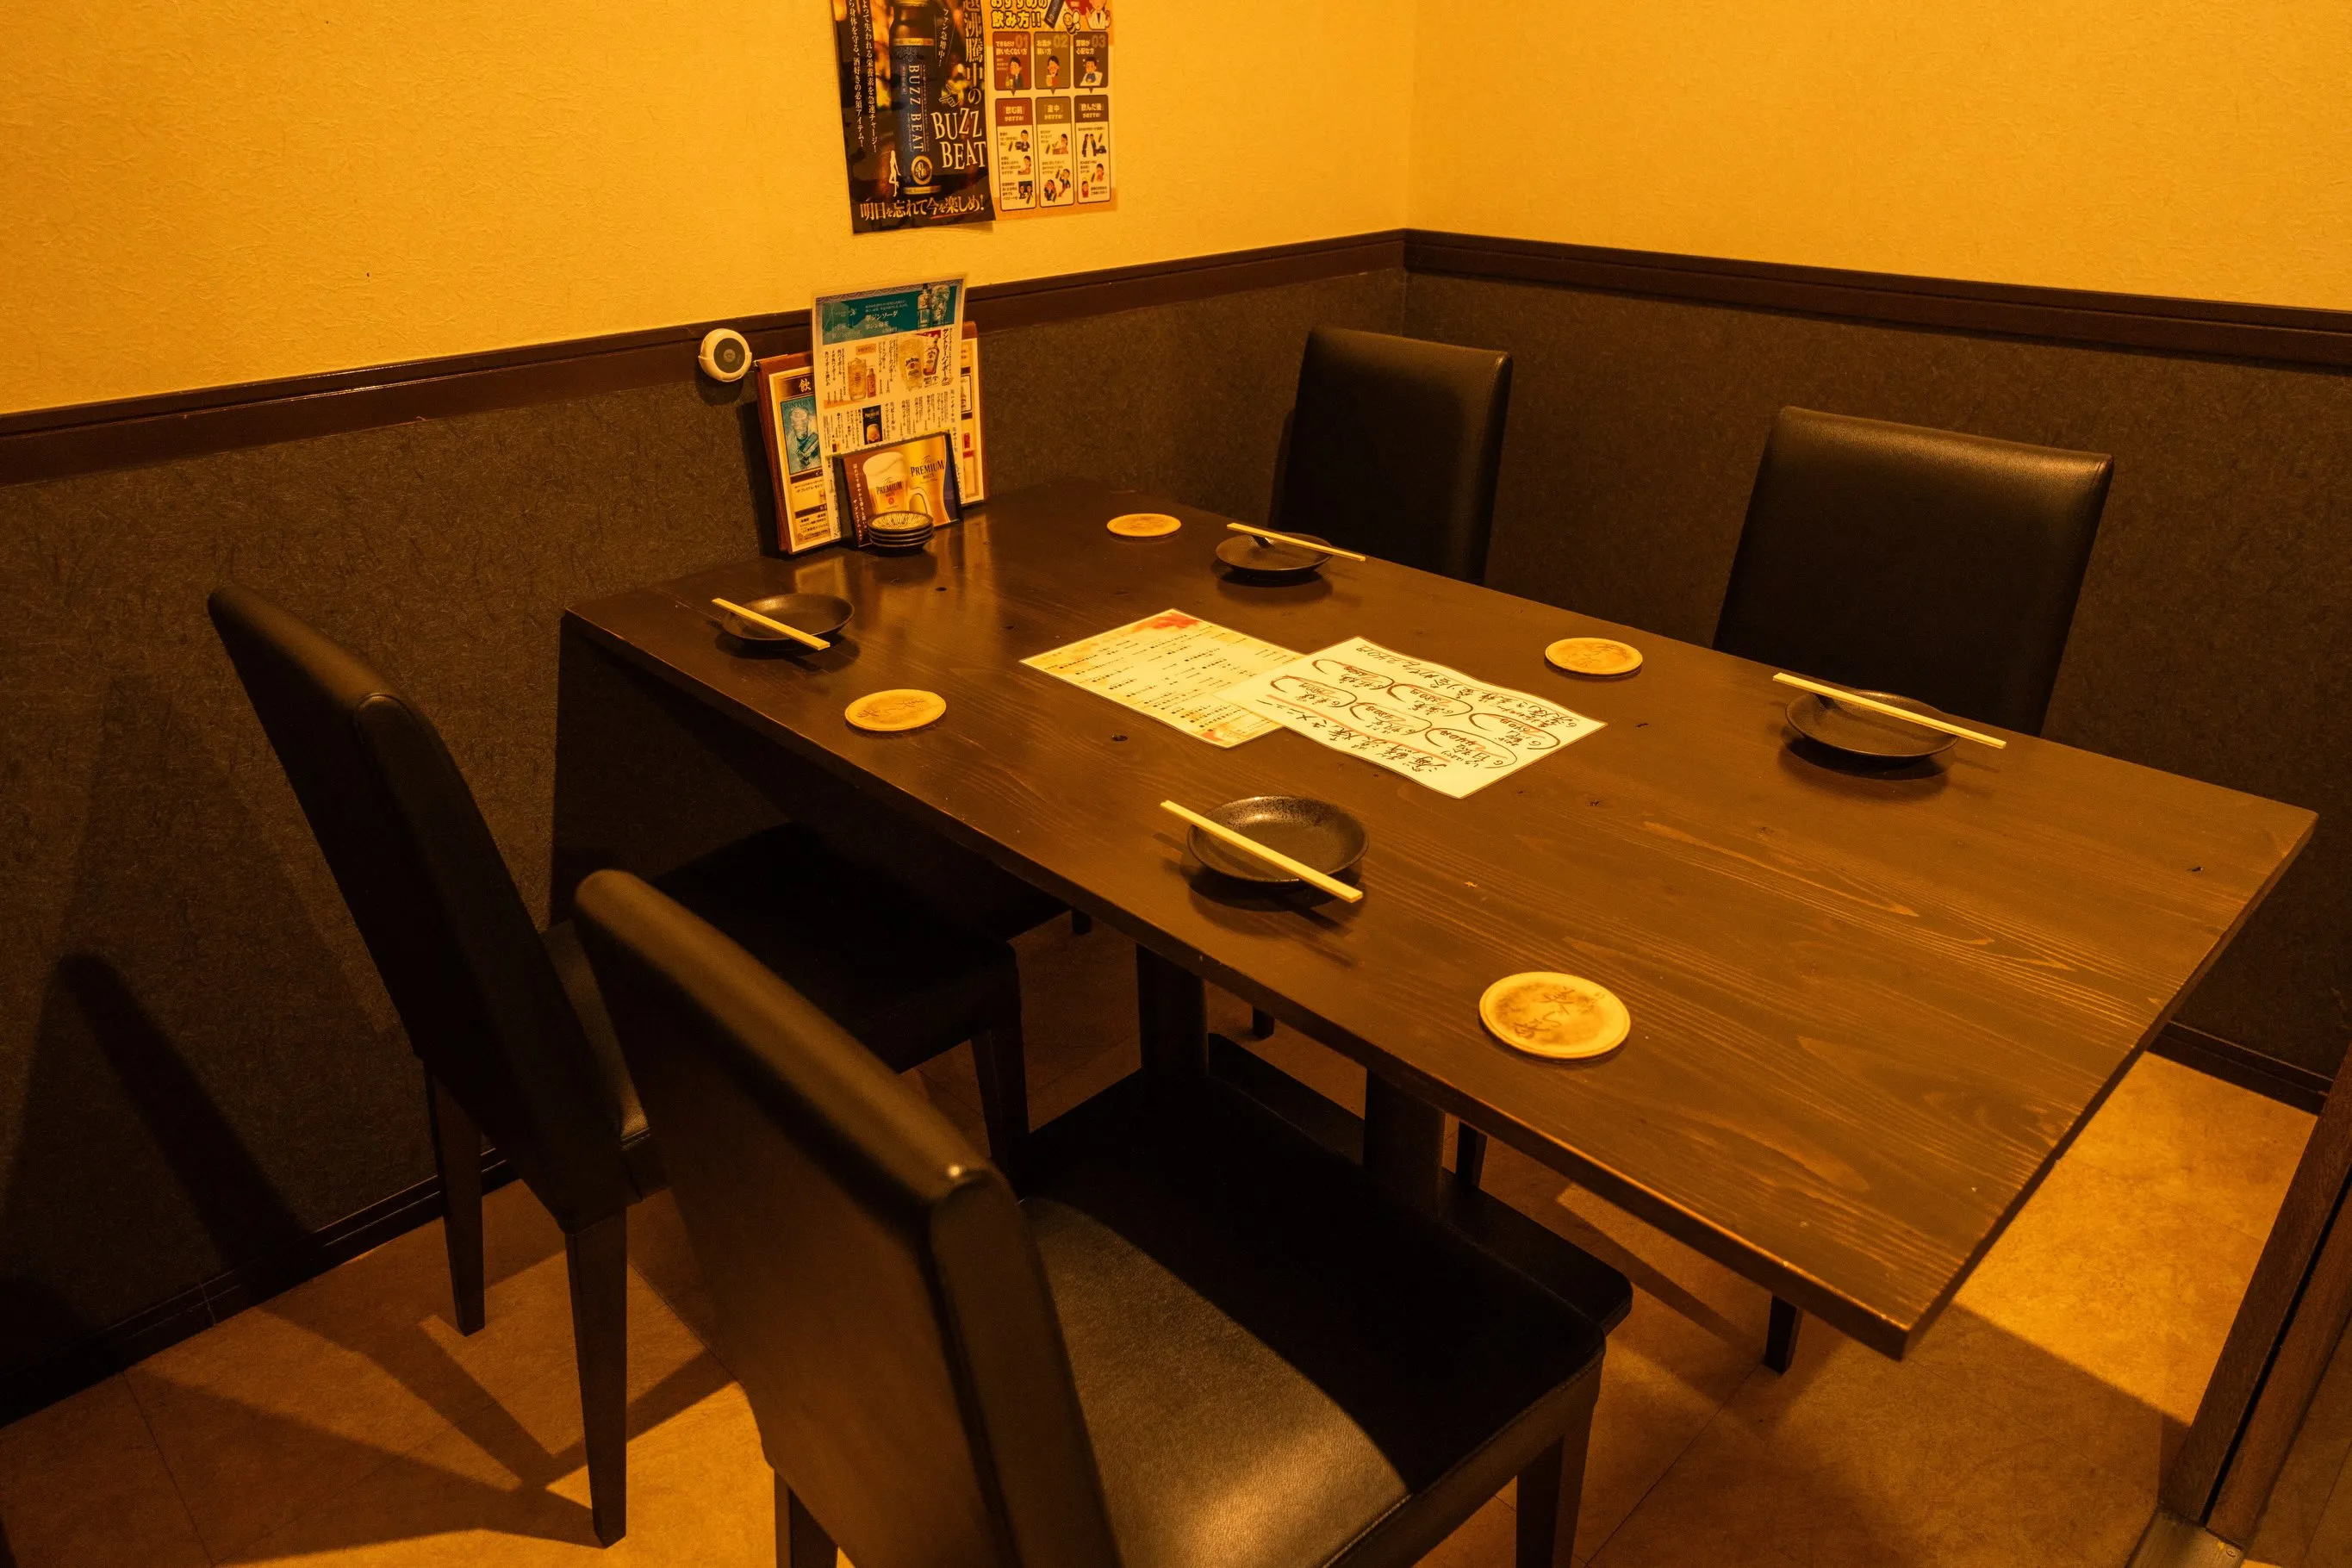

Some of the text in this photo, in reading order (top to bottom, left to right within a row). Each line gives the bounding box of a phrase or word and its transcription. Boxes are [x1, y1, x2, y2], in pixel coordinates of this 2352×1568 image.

[909, 65, 921, 105] BUZZ
[911, 113, 924, 152] BEAT
[930, 107, 982, 140] BUZZ
[940, 139, 986, 170] BEAT
[911, 459, 944, 476] PREMIUM
[876, 481, 903, 495] PREMIUM
